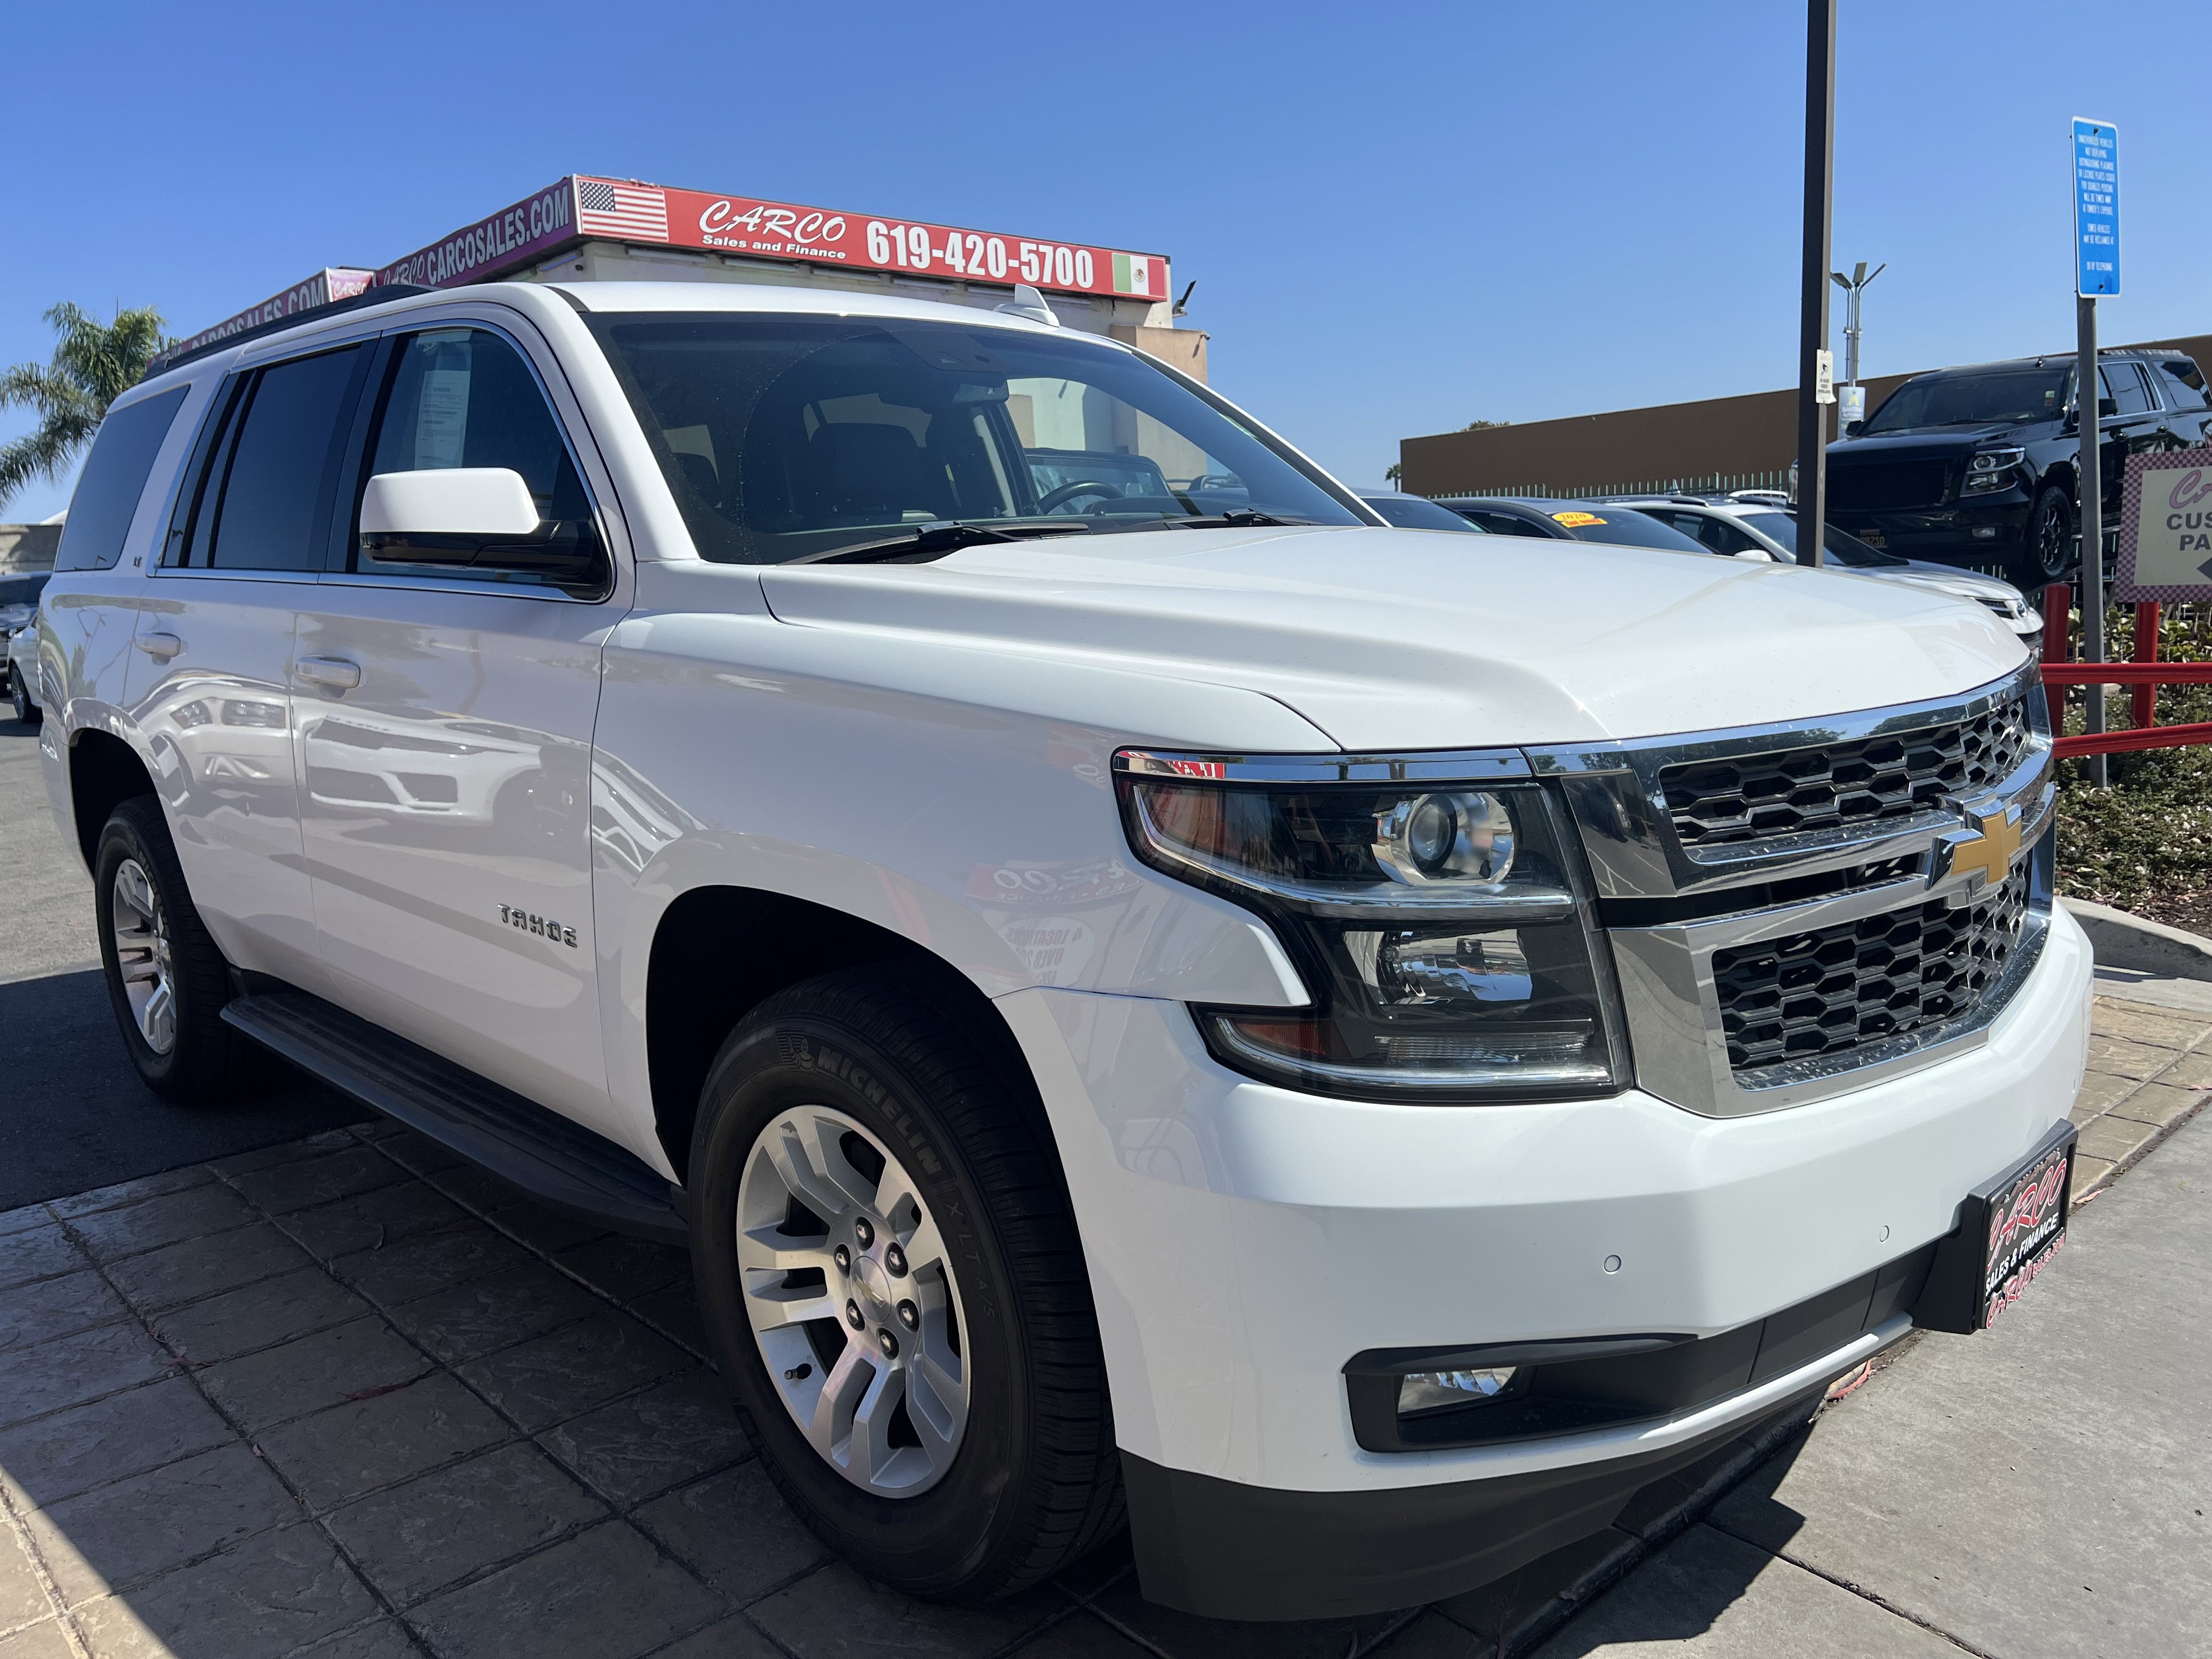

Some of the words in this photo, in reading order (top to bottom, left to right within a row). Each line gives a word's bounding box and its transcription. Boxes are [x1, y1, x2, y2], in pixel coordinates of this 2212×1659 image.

[427, 185, 569, 285] CARCOSALES.COM
[698, 200, 847, 244] CARCO
[702, 234, 748, 249] Sales
[752, 241, 782, 252] and
[785, 242, 847, 259] Finance
[866, 221, 1094, 289] 619-420-5700
[497, 903, 578, 949] TAHOE
[817, 1046, 943, 1175] MICHELIN
[1985, 1255, 2011, 1297] SALES
[2010, 1248, 2018, 1268] &
[2018, 1211, 2059, 1260] FINANCE
[1987, 1158, 2067, 1275] CARCO
